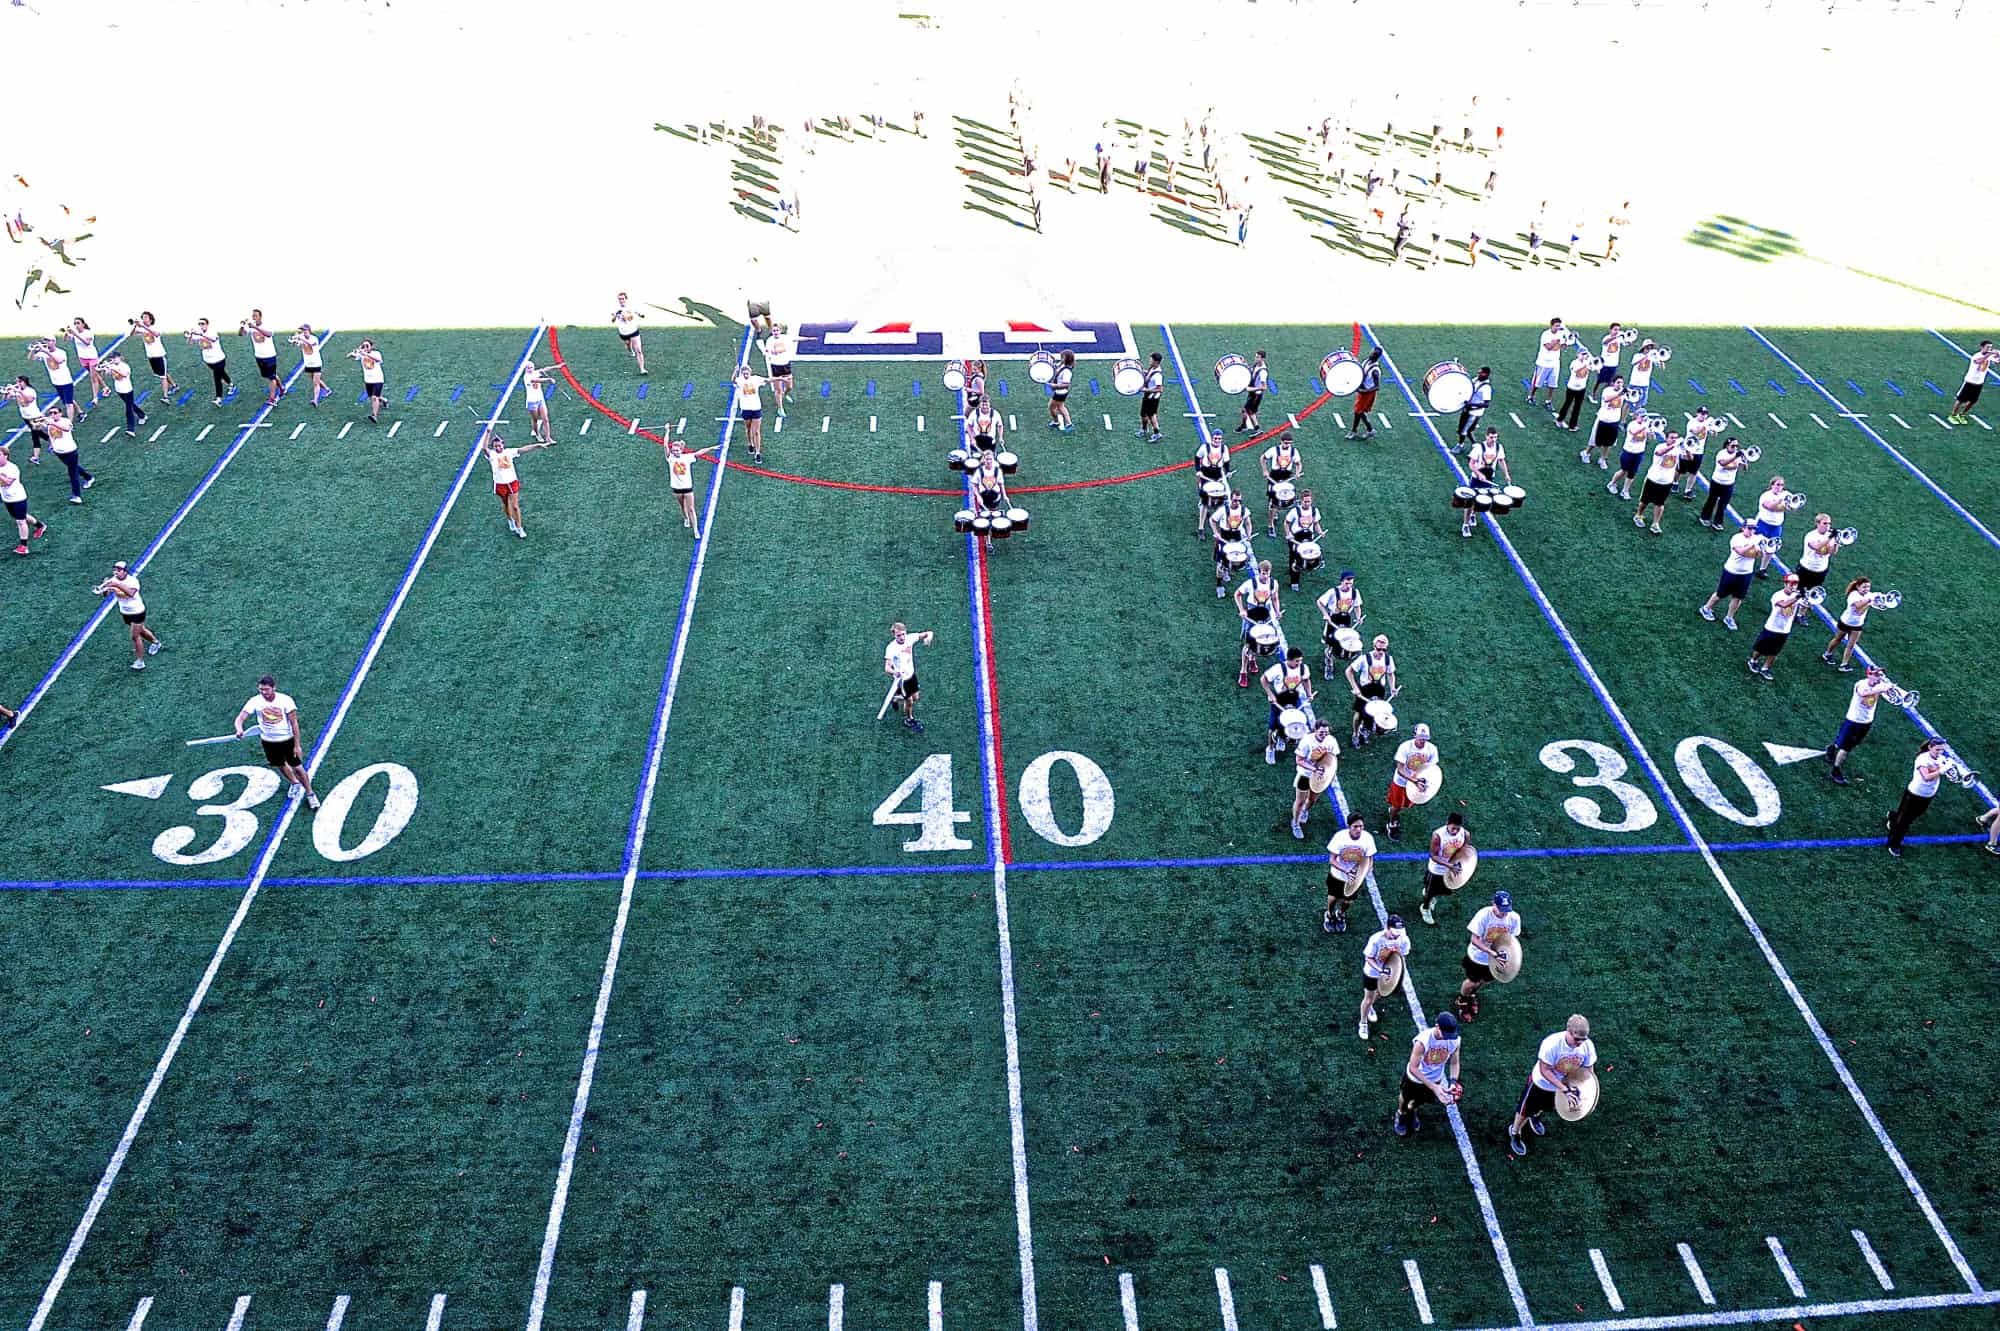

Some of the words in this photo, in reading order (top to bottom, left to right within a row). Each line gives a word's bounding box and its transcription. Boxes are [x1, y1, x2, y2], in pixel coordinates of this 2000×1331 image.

[152, 763, 419, 866] 30
[873, 751, 1115, 854] 40
[1539, 736, 1781, 834] 30
